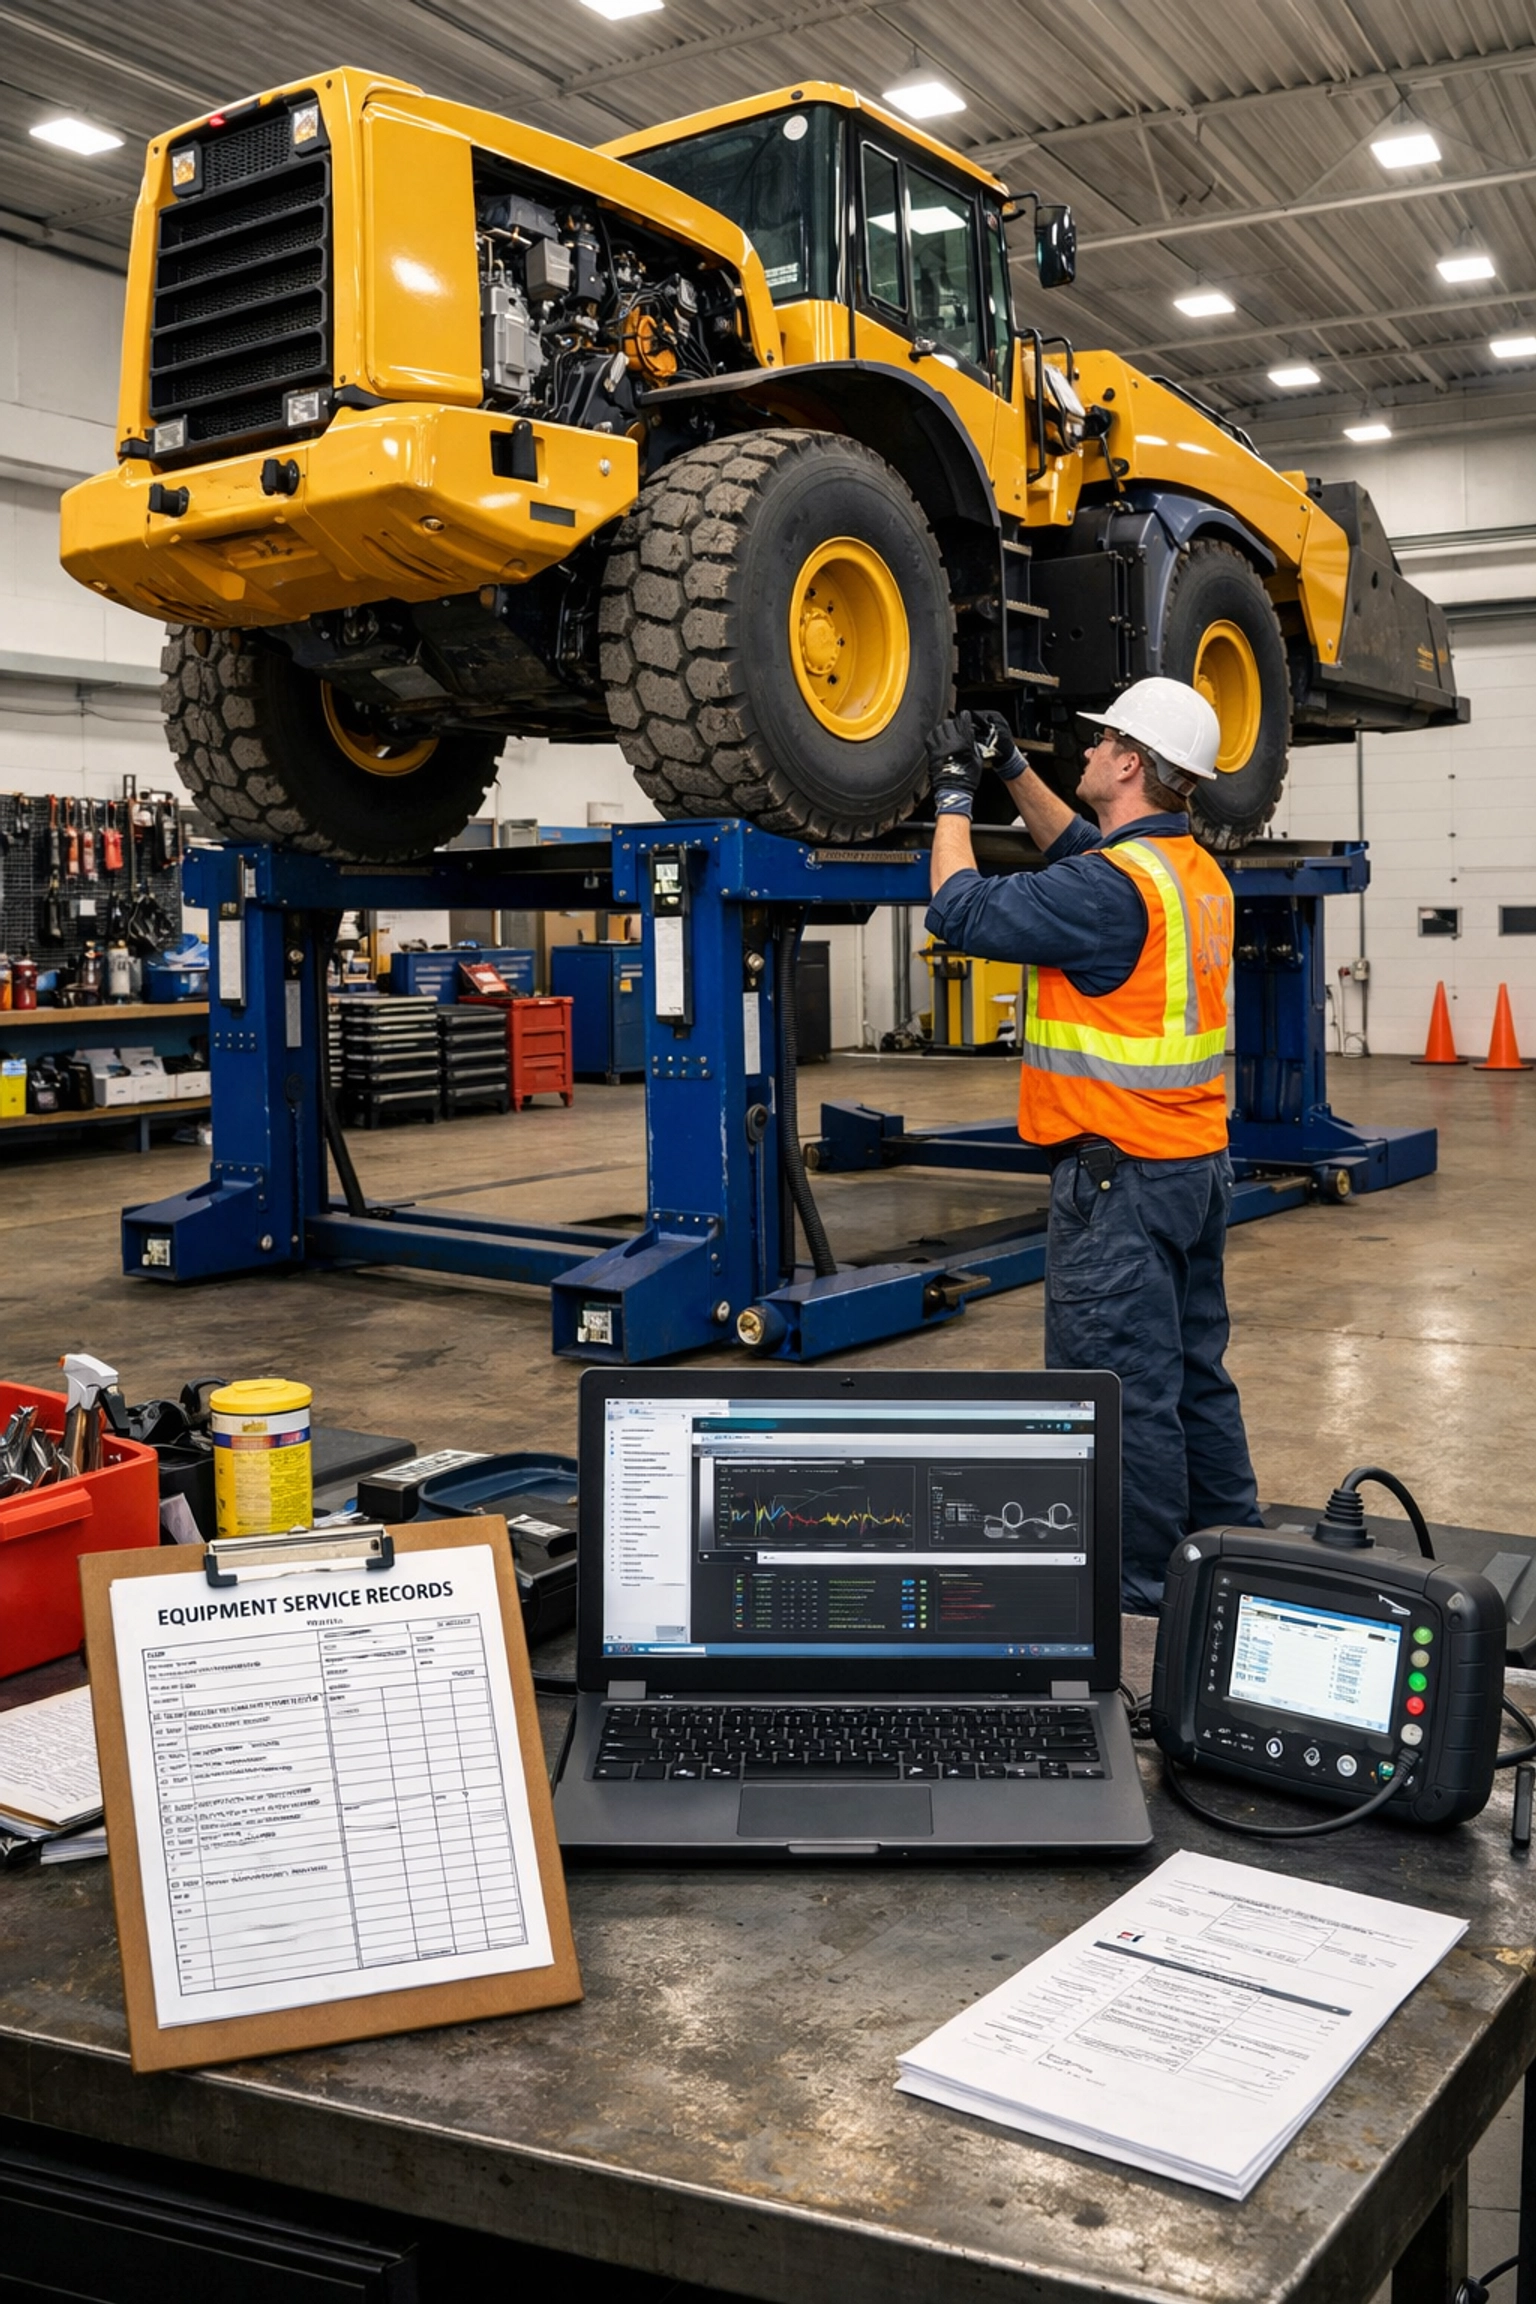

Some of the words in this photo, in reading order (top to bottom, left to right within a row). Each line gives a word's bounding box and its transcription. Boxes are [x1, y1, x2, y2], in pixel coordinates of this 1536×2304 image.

[157, 1597, 278, 1626] EQUIPMENT
[283, 1589, 362, 1614] SERVICE
[365, 1580, 454, 1605] RECORDS
